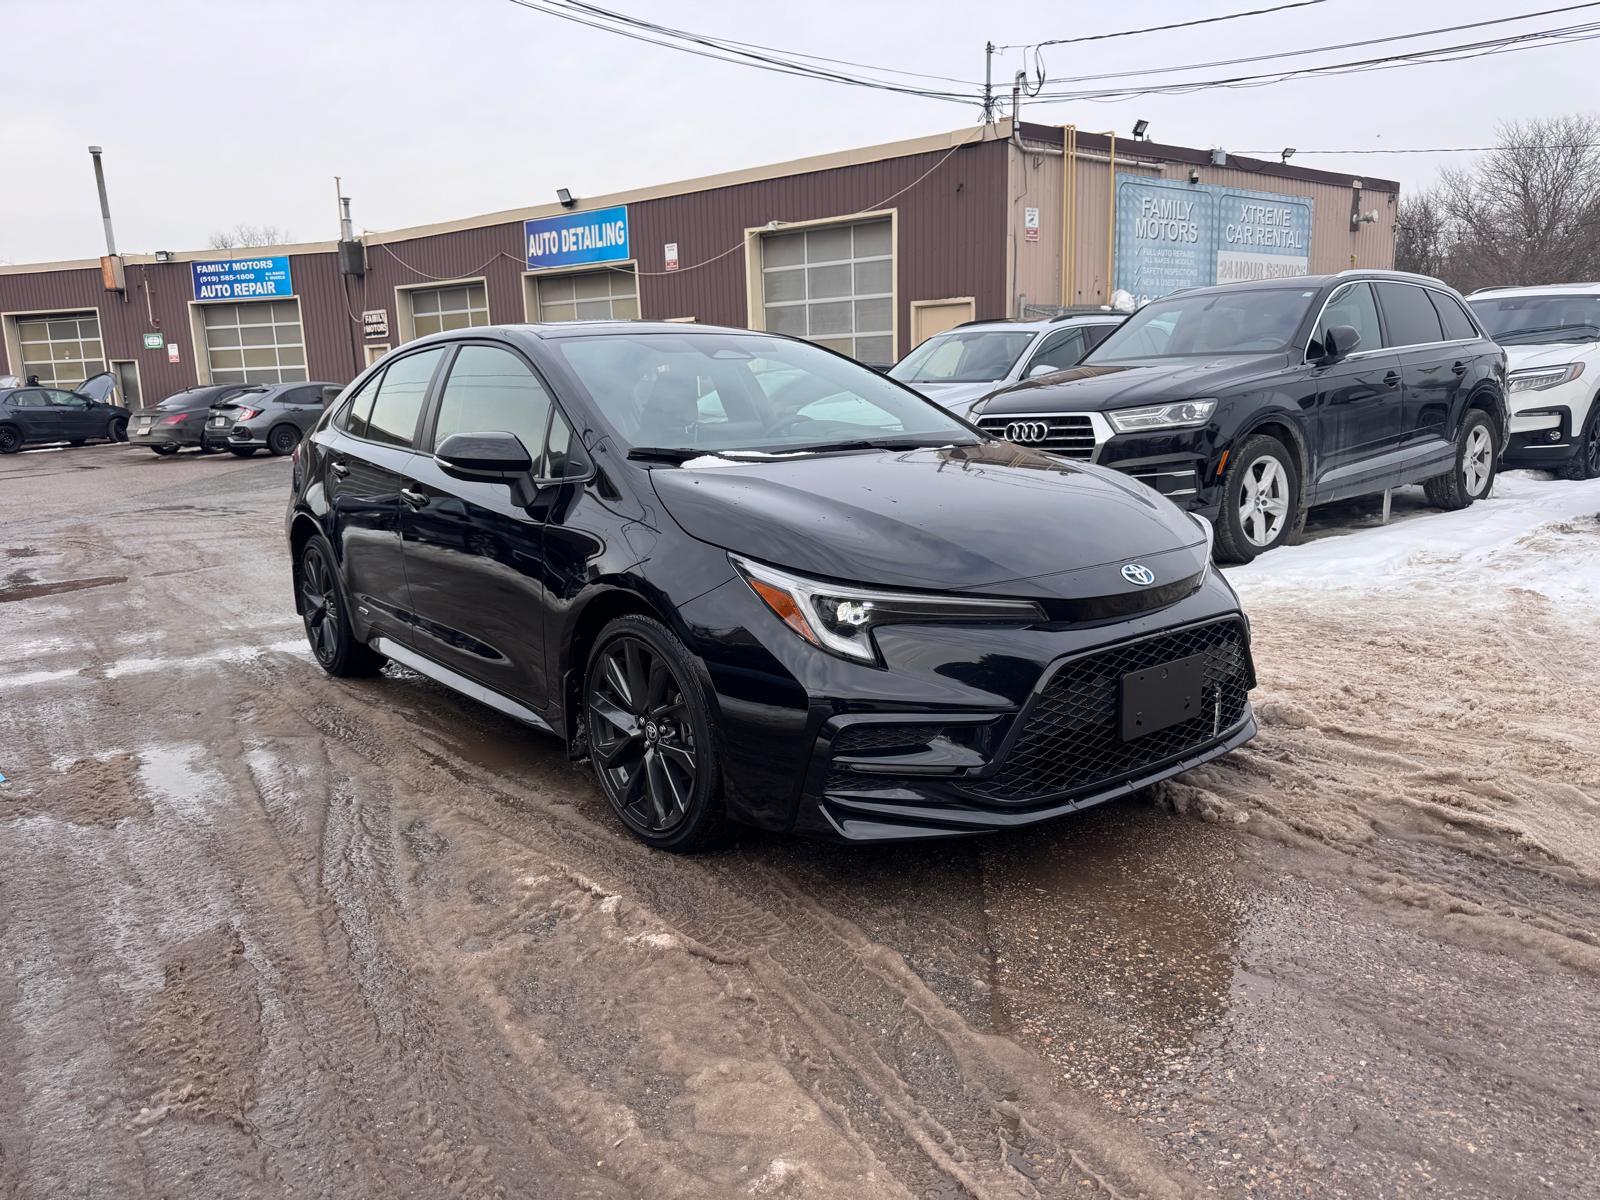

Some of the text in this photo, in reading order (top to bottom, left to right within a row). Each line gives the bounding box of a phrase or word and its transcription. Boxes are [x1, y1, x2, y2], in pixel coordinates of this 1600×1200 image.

[1142, 197, 1194, 221] FAMILY
[1240, 204, 1292, 228] XTREME
[528, 220, 625, 257] AUTO DETAILING
[1135, 218, 1198, 243] MOTORS
[1226, 224, 1303, 249] CAR RENTAL
[196, 260, 273, 274] FAMILY MOTORS
[1219, 260, 1233, 278] 24
[1233, 261, 1263, 280] HOUR
[200, 275, 219, 284] (519)
[200, 281, 276, 298] AUTO REPAIR
